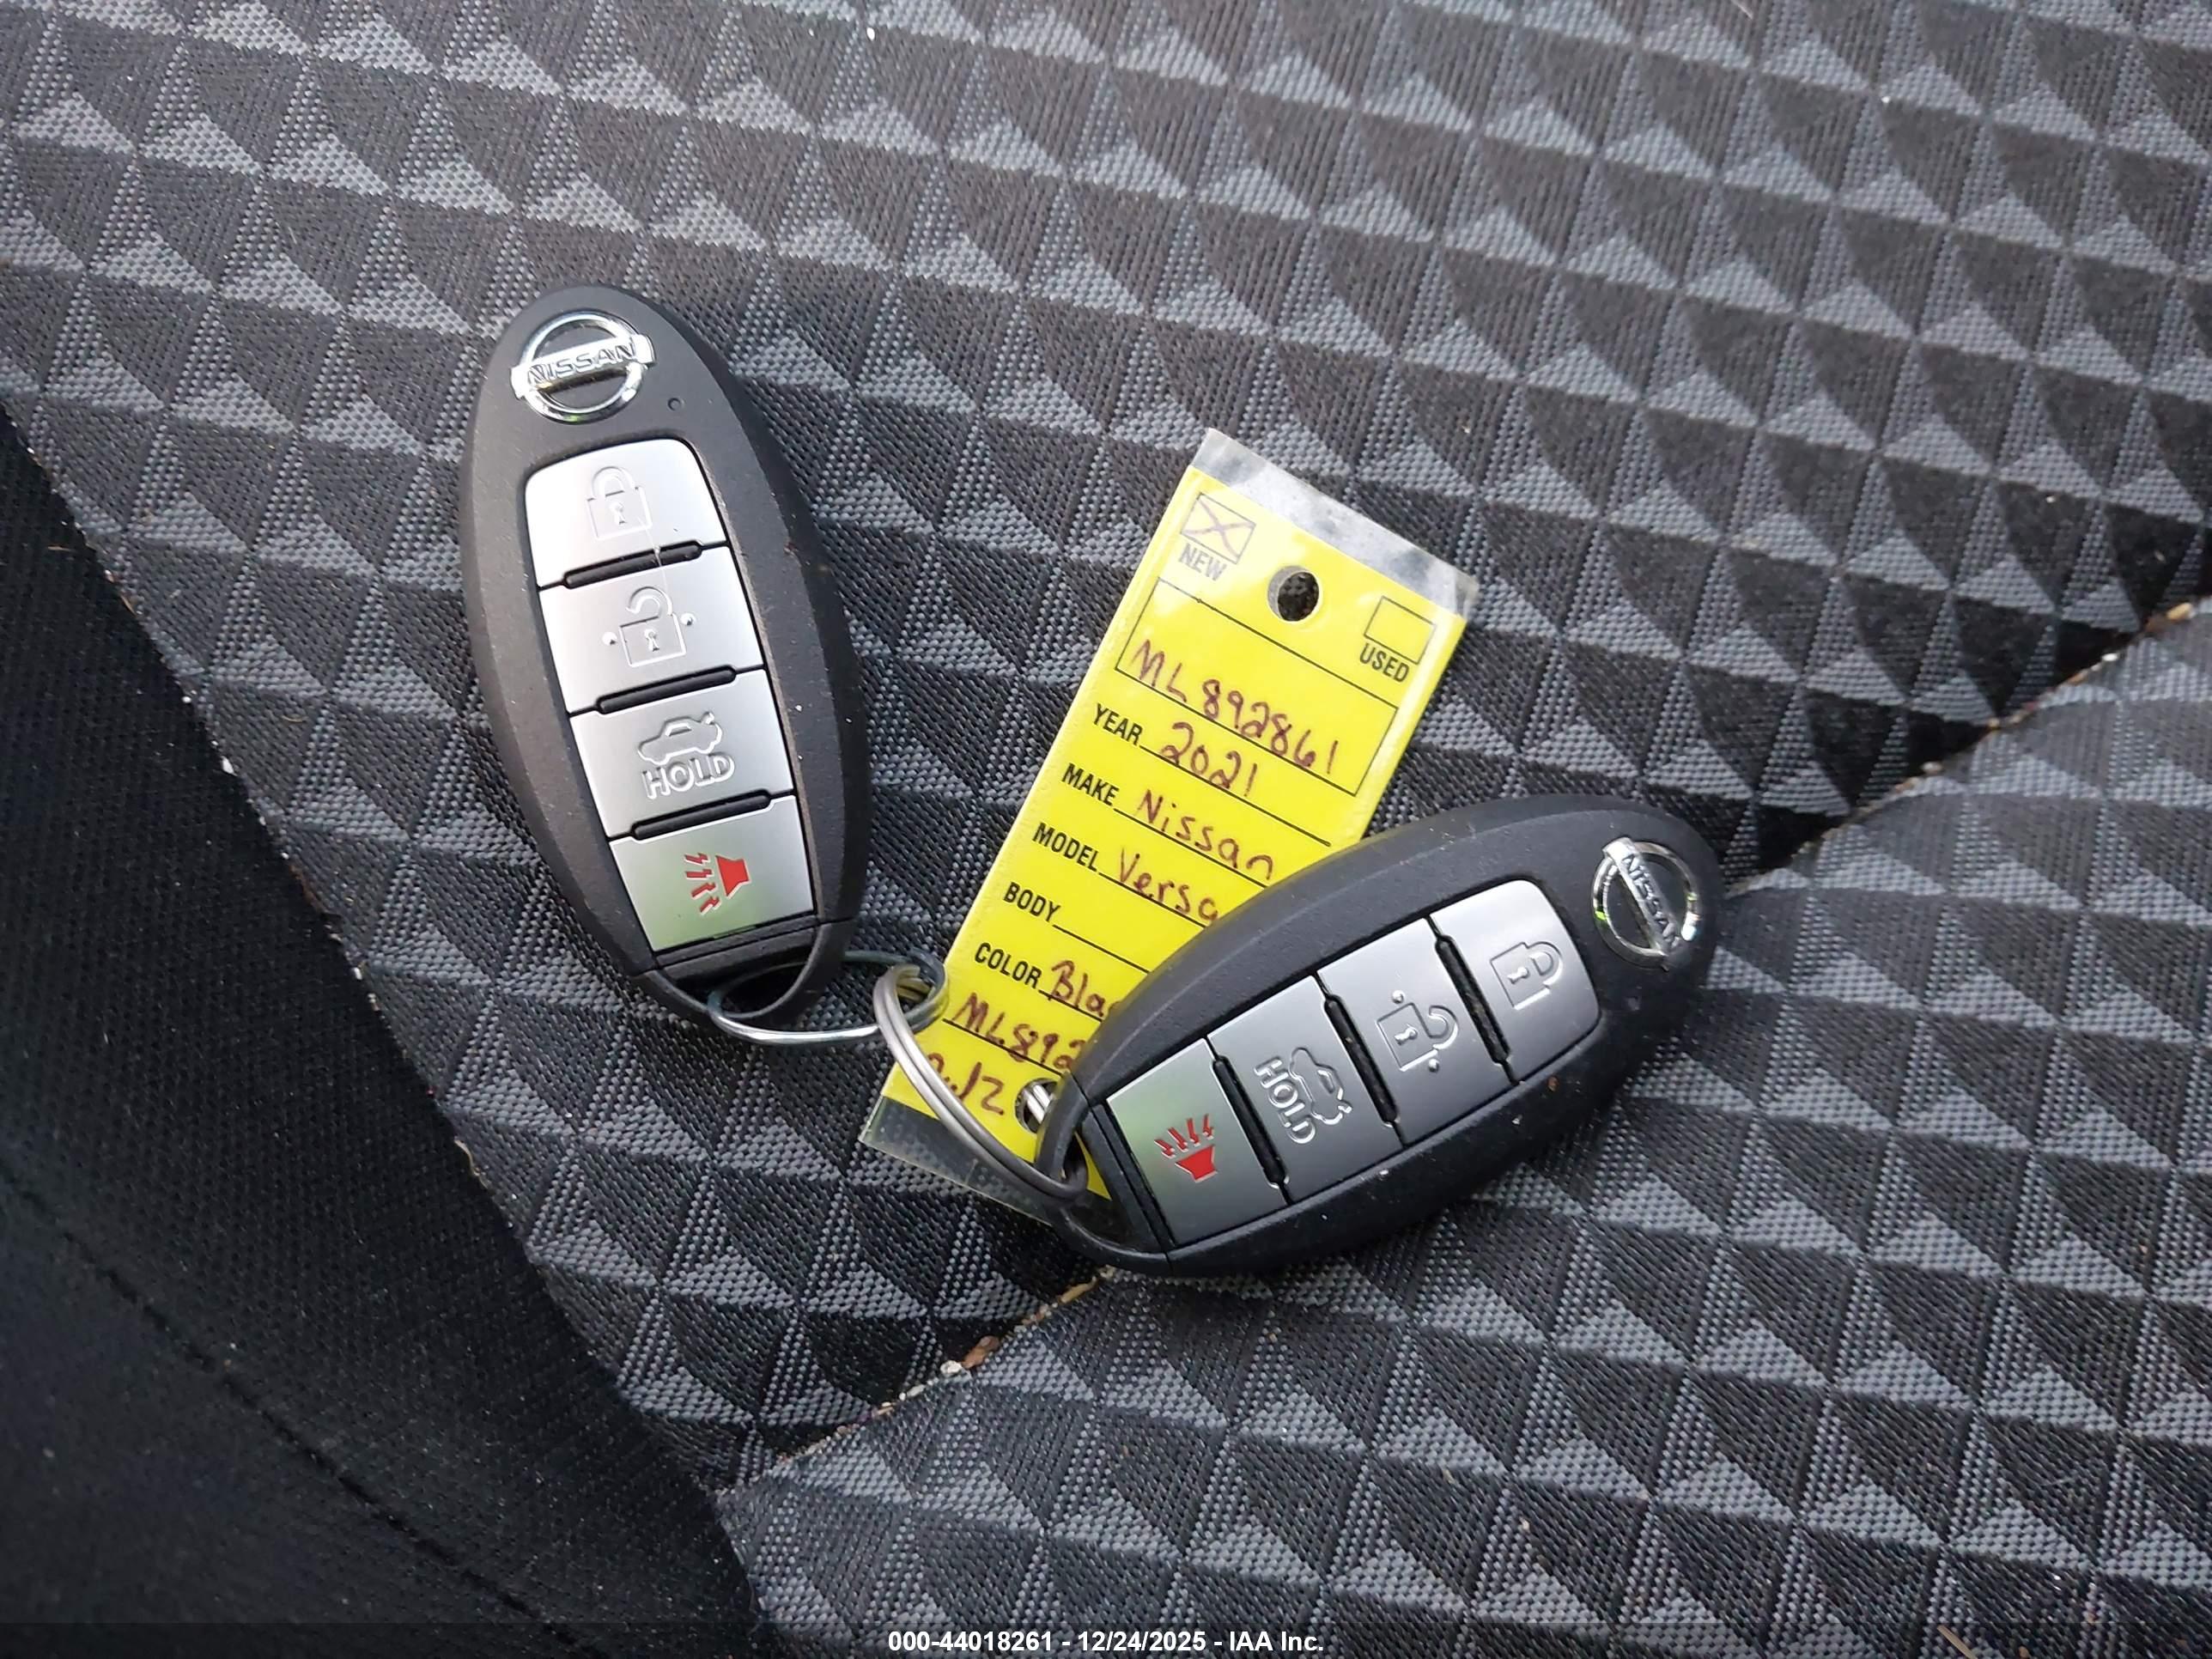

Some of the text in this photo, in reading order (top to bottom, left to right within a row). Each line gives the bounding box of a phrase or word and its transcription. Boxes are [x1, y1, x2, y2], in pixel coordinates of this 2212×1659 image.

[526, 341, 636, 386] NISSAN
[1178, 543, 1227, 581] NEW
[1358, 646, 1410, 683] USED
[1093, 703, 1257, 797] YEAR 2021
[642, 752, 735, 799] HOLD
[1061, 763, 1273, 880] MAKE Nissan
[1032, 823, 1101, 873] MODEL
[1004, 882, 1061, 923] BODY
[975, 941, 1042, 989] COLOR
[1254, 1055, 1316, 1145] HOLD
